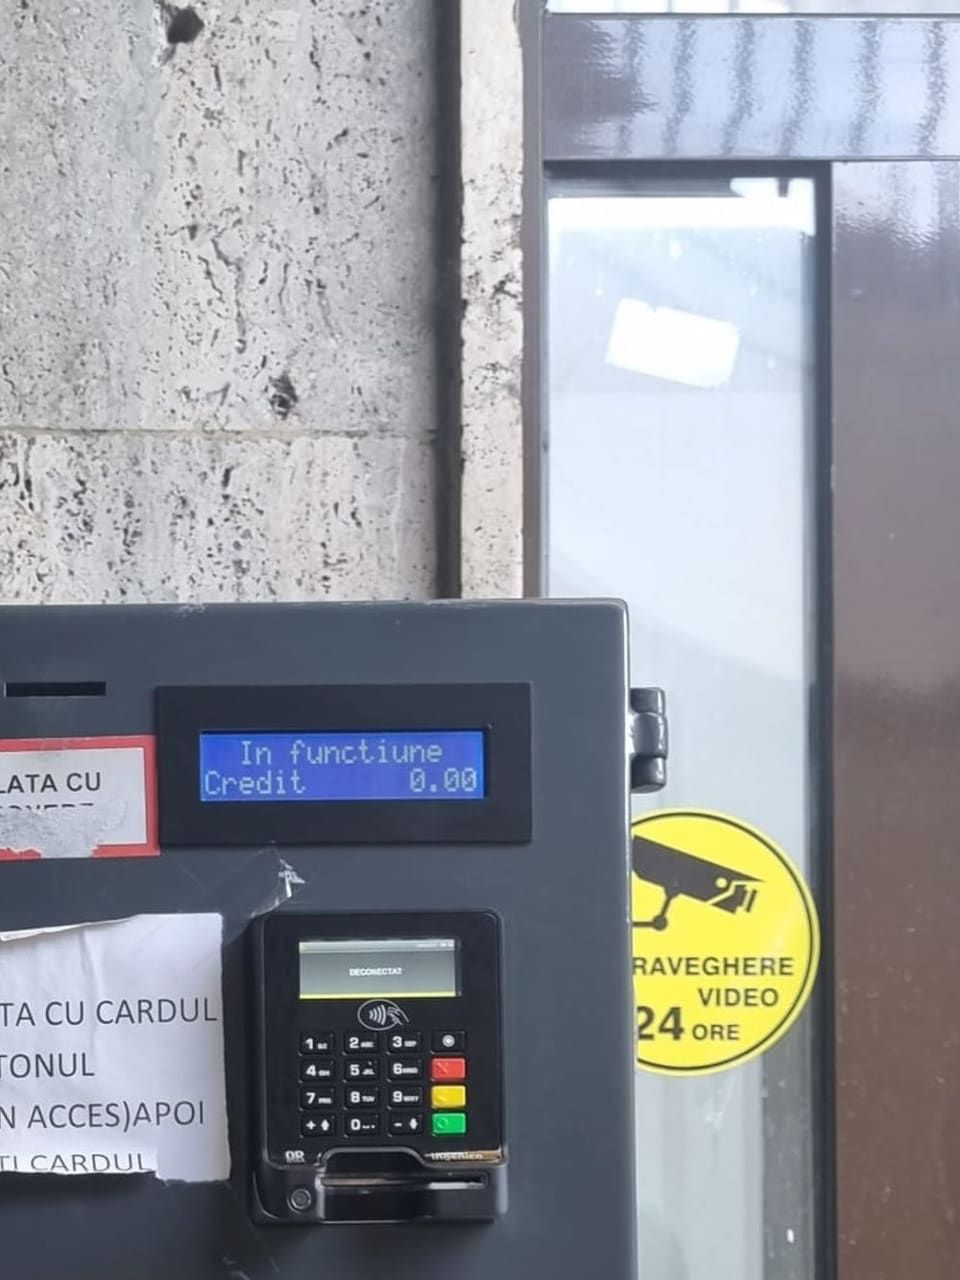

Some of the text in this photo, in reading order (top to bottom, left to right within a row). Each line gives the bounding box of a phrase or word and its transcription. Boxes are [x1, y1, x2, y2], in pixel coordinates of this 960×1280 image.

[241, 739, 442, 763] In functiune
[66, 772, 101, 792] CU
[205, 768, 478, 795] Credit 0.00
[632, 957, 794, 976] RAVEGHERE
[698, 988, 779, 1007] VIDEO
[45, 1001, 85, 1026] CU
[95, 998, 217, 1024] CARDUL
[637, 1005, 740, 1041] 24 ORE
[305, 1038, 314, 1050] 1
[349, 1037, 360, 1049] 2
[392, 1036, 403, 1048] 3
[305, 1064, 317, 1077] 4
[350, 1064, 360, 1076] 5
[392, 1063, 402, 1075] 6
[305, 1092, 316, 1104] 7
[350, 1091, 360, 1103] 8
[392, 1090, 402, 1103] 9
[28, 1101, 204, 1133] ACCES)APOI
[350, 1118, 361, 1131] 0
[30, 1153, 153, 1173] CARDUL
